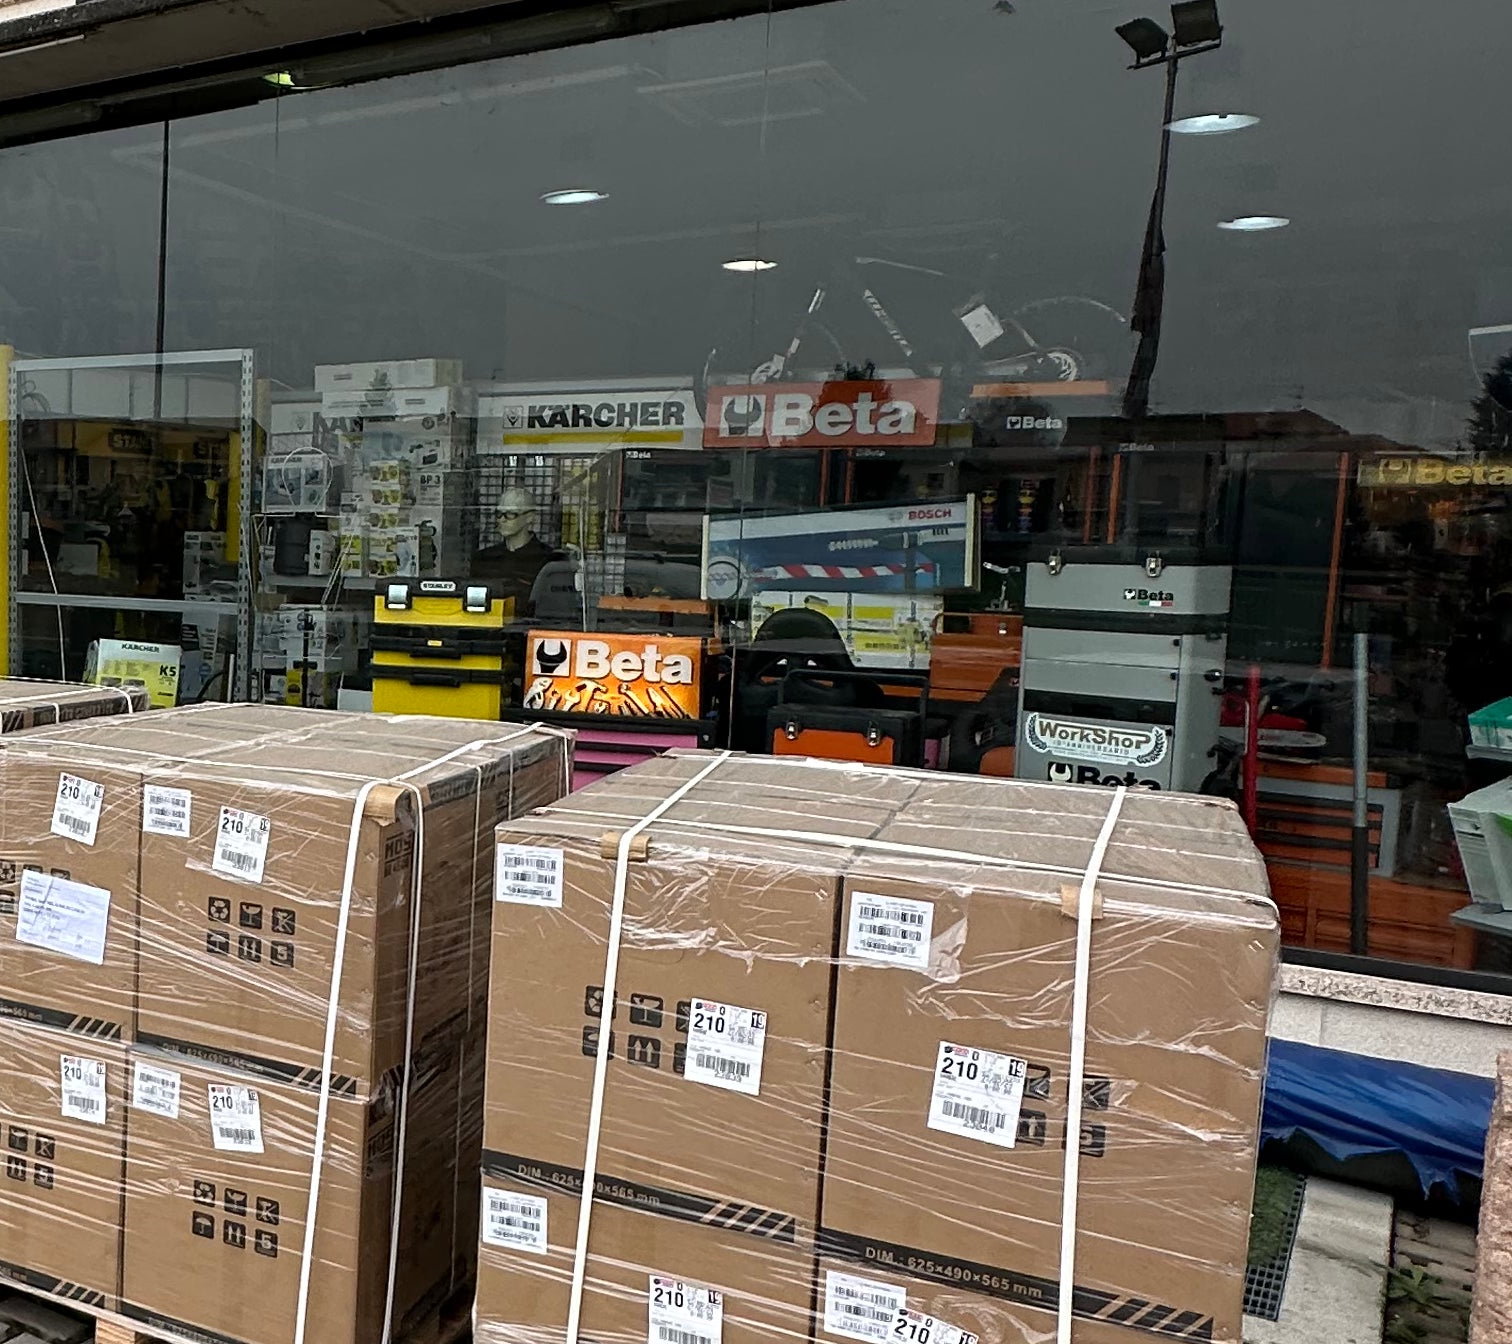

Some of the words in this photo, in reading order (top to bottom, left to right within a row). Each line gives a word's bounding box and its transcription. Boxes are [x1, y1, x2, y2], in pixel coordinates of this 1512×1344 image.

[771, 392, 916, 436] Beta
[1022, 416, 1063, 429] Beta
[1415, 458, 1512, 486] Beta
[908, 509, 951, 520] BOSCH
[1138, 589, 1174, 601] Beta
[576, 640, 693, 685] Beta
[61, 783, 80, 799] 210
[222, 817, 243, 833] 210
[694, 1013, 725, 1033] 210
[64, 1065, 82, 1080] 210
[942, 1057, 978, 1080] 210
[213, 1095, 233, 1109] 210
[654, 1287, 684, 1308] 210
[1012, 1282, 1043, 1299] mm
[894, 1318, 930, 1344] 210
